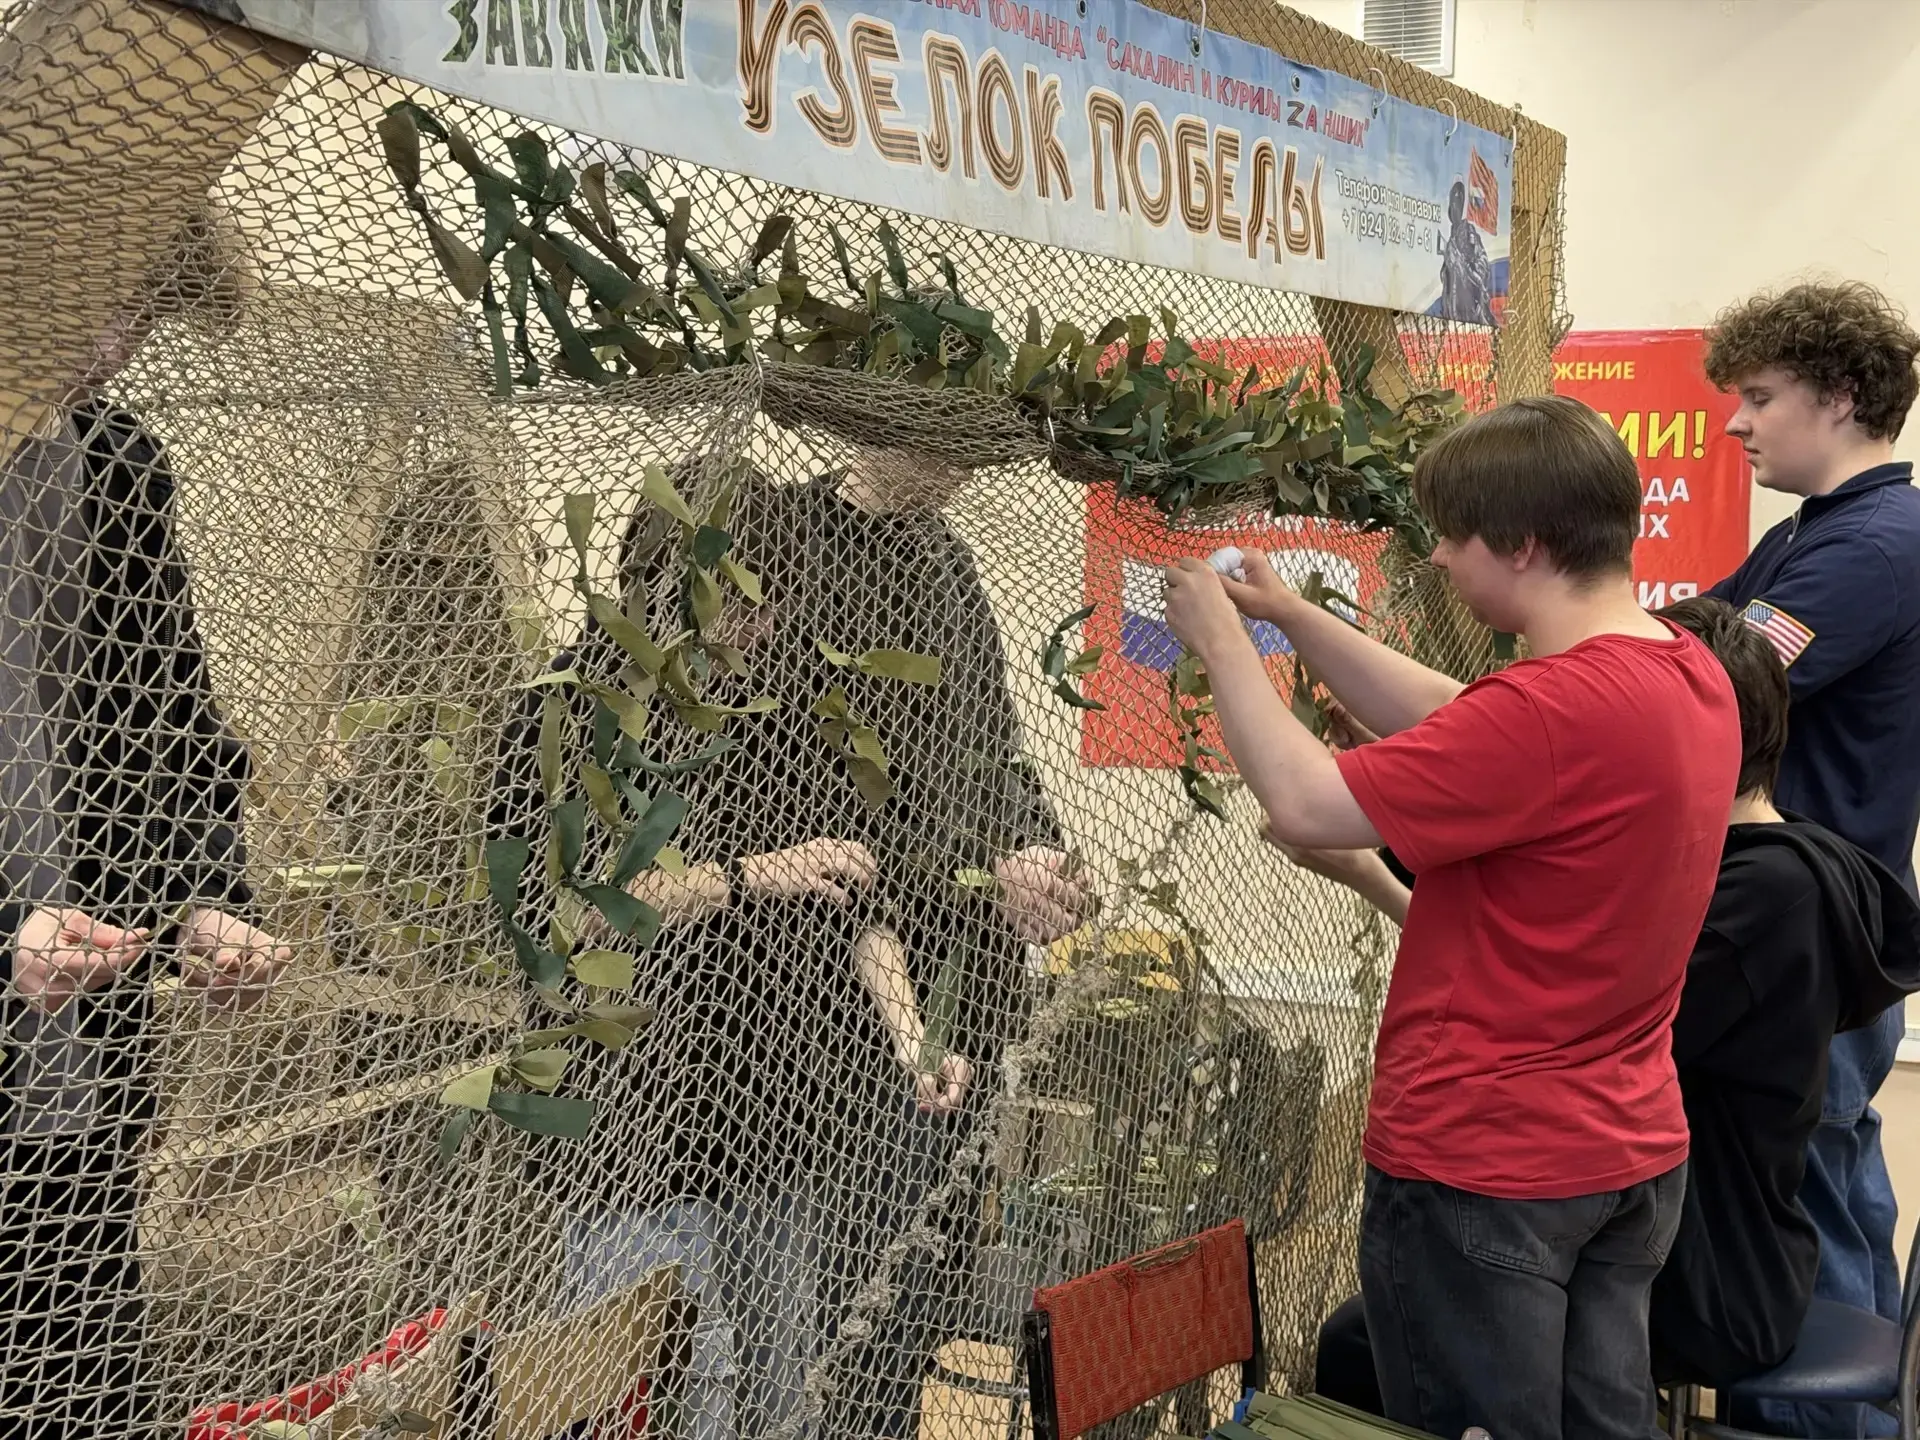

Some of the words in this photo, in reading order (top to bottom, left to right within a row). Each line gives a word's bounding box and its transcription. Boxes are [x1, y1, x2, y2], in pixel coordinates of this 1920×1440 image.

[1201, 68, 1212, 100] И
[736, 0, 1074, 201] УЗЕЛОК
[1087, 90, 1326, 265] ПОБЕДЫ
[1334, 168, 1387, 208] Телефон
[1553, 360, 1636, 381] ЖЕНИЕ
[1599, 410, 1708, 460] МИ!
[1641, 476, 1691, 506] ДА
[1633, 580, 1699, 611] ИЯ
